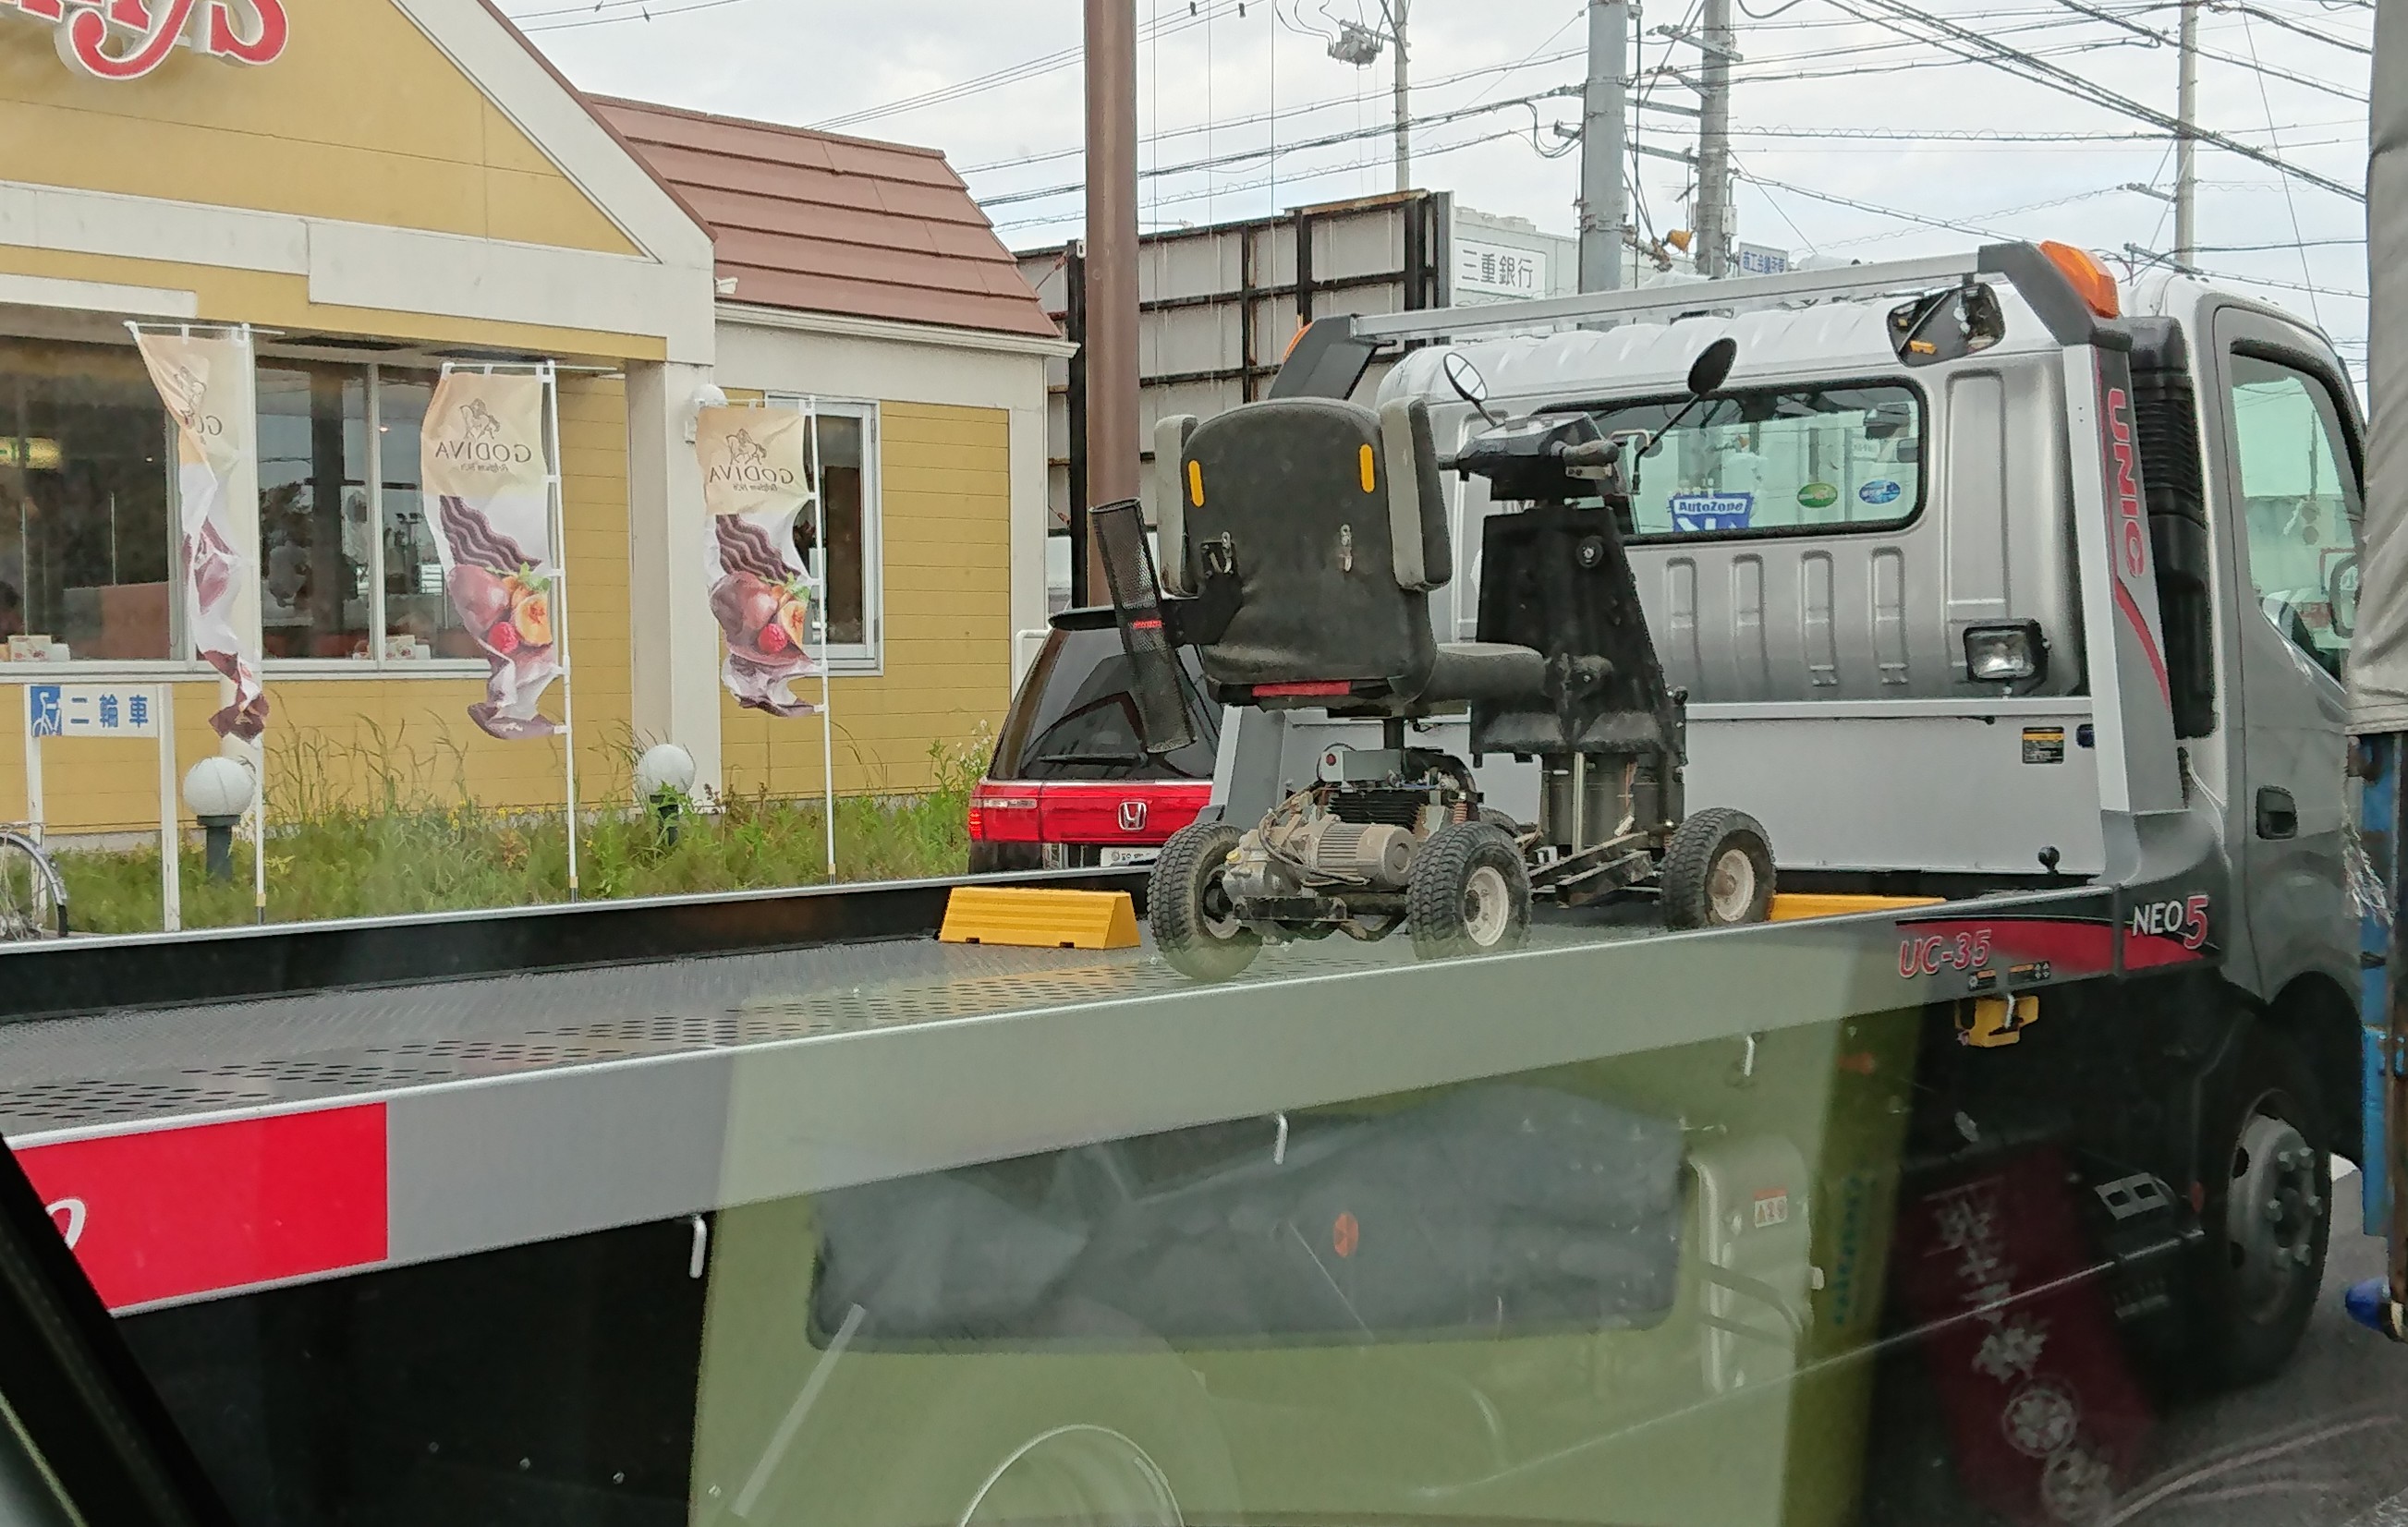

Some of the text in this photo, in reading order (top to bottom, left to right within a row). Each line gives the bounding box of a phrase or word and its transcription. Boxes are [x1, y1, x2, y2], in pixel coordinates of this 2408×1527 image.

[1462, 248, 1534, 288] 三重銀行
[2108, 387, 2146, 578] UNIC
[1678, 501, 1745, 513] AutoZone
[70, 694, 149, 728] 二輪車
[1898, 928, 1992, 979] UC-35
